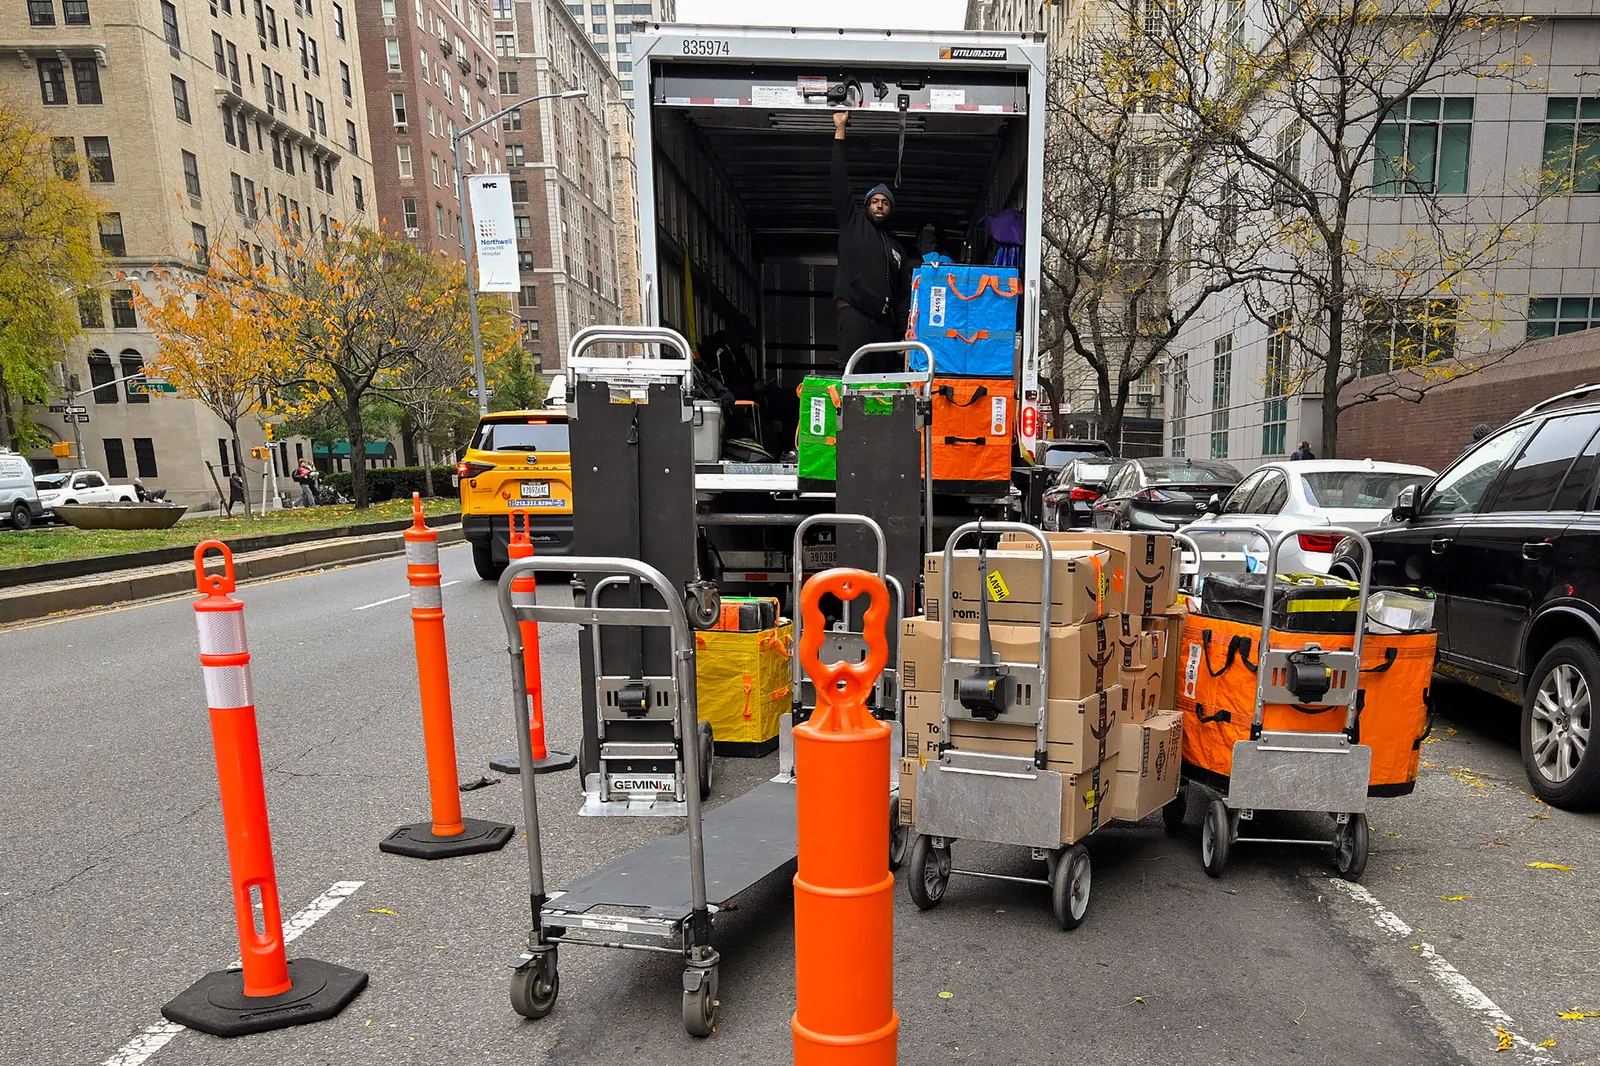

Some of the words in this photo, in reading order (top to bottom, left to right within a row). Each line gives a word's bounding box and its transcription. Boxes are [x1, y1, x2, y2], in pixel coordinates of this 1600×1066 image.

[682, 39, 730, 55] 835974
[987, 574, 1006, 600] HEAVY
[952, 607, 980, 619] rom:
[613, 780, 662, 790] GEMINI
[662, 783, 672, 791] XL
